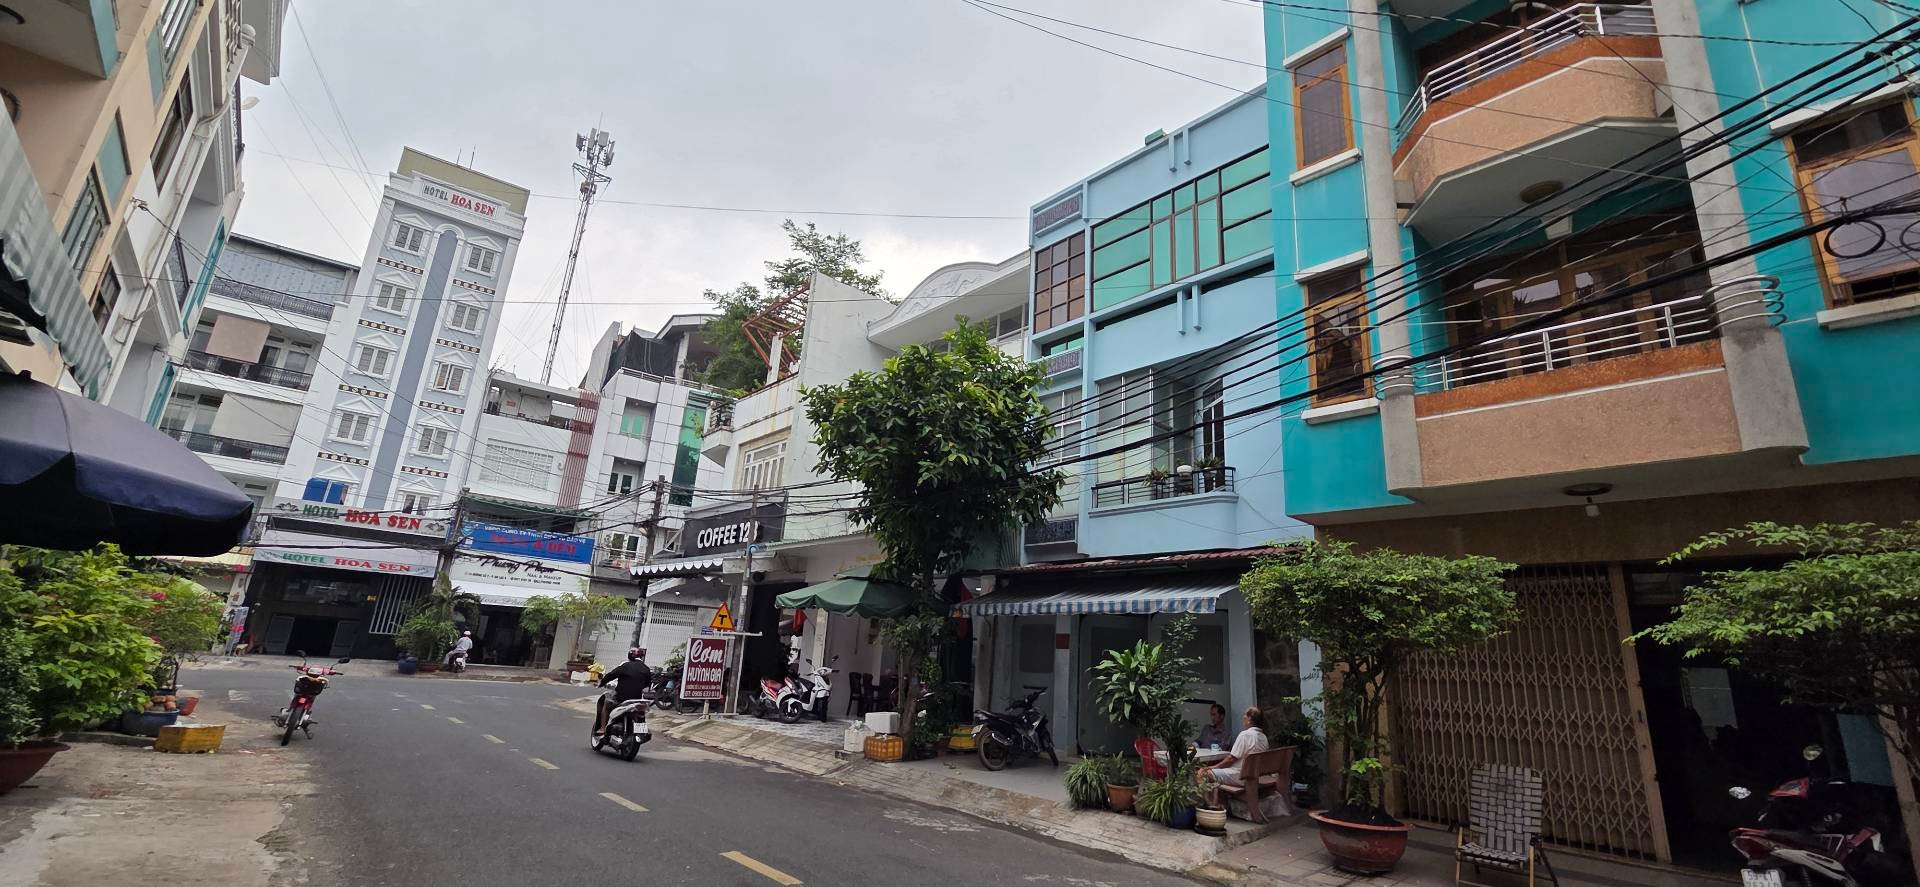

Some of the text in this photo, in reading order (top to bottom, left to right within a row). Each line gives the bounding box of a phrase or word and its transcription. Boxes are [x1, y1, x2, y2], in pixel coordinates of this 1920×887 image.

[424, 185, 495, 216] HOTEL HOA SEN
[302, 504, 422, 529] HOTEL HOA SEN
[697, 522, 738, 549] COFFEE
[282, 552, 412, 572] HOTEL HOA SEN
[690, 639, 724, 664] Cơm
[711, 668, 722, 682] GIA
